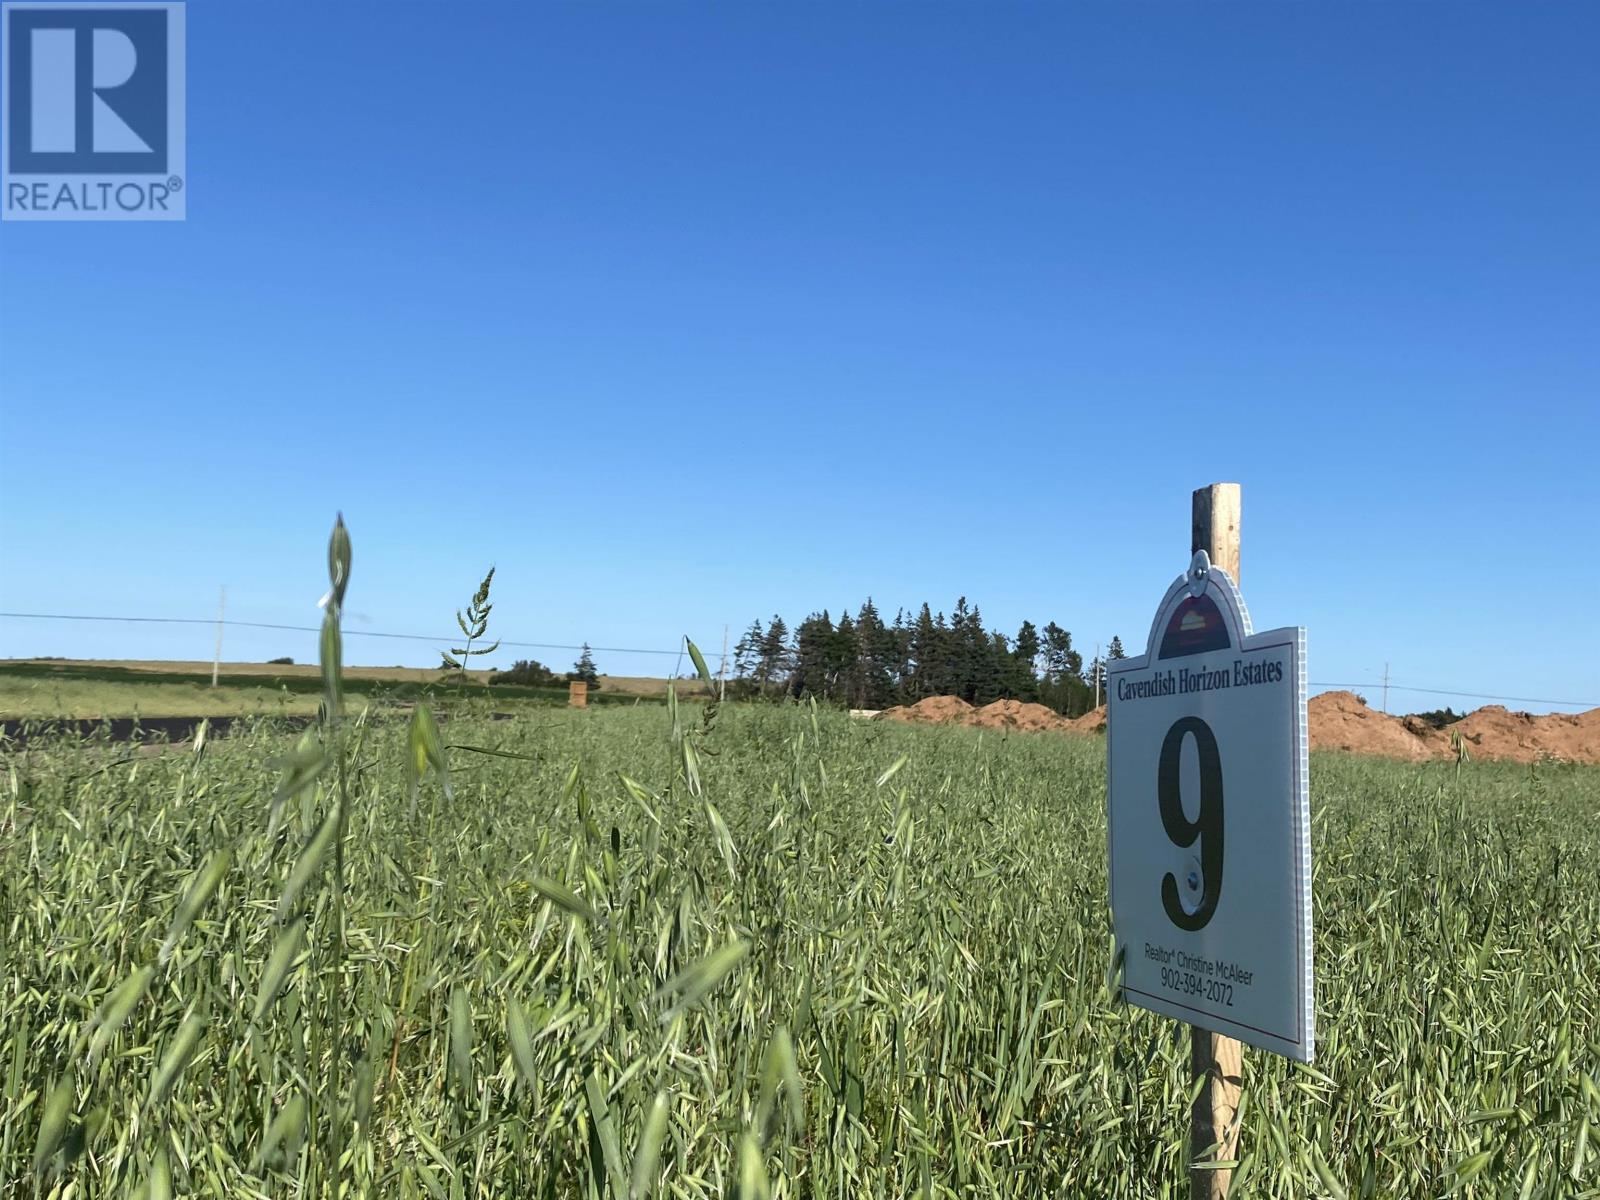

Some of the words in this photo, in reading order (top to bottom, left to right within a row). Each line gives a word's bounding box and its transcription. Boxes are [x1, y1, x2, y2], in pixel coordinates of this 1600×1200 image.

[1117, 670, 1176, 701] Cavendish
[1179, 665, 1230, 694] Horizon
[1233, 659, 1282, 687] Estates
[1158, 716, 1224, 932] 9
[1161, 967, 1233, 1006] 902-394-2072
[1177, 951, 1213, 976] Christine
[1215, 960, 1253, 986] McAleer
